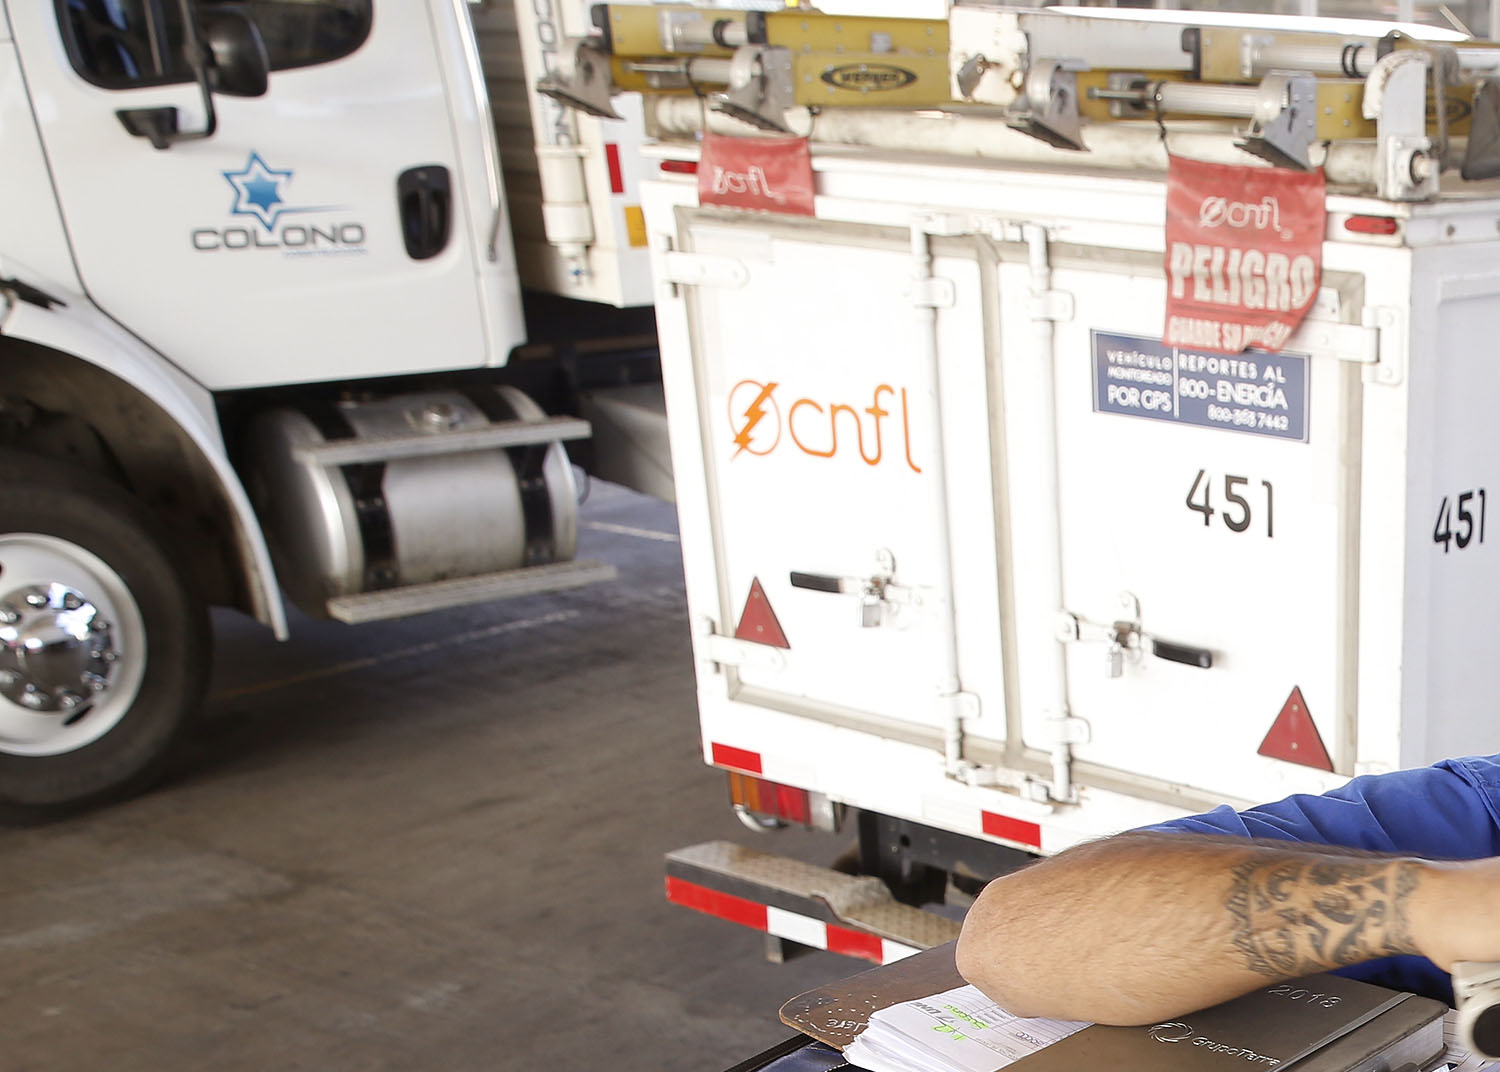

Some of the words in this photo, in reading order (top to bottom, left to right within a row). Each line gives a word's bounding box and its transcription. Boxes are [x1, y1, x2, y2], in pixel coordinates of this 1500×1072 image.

[193, 223, 366, 250] COLONO
[1170, 241, 1316, 312] PELIGRO
[1179, 353, 1257, 380] REPORTES
[1263, 365, 1287, 383] AL
[1107, 384, 1140, 408] POR
[1141, 389, 1172, 412] GPS
[1186, 470, 1274, 537] 451
[1433, 488, 1487, 553] 451
[1268, 984, 1342, 1008] 2018
